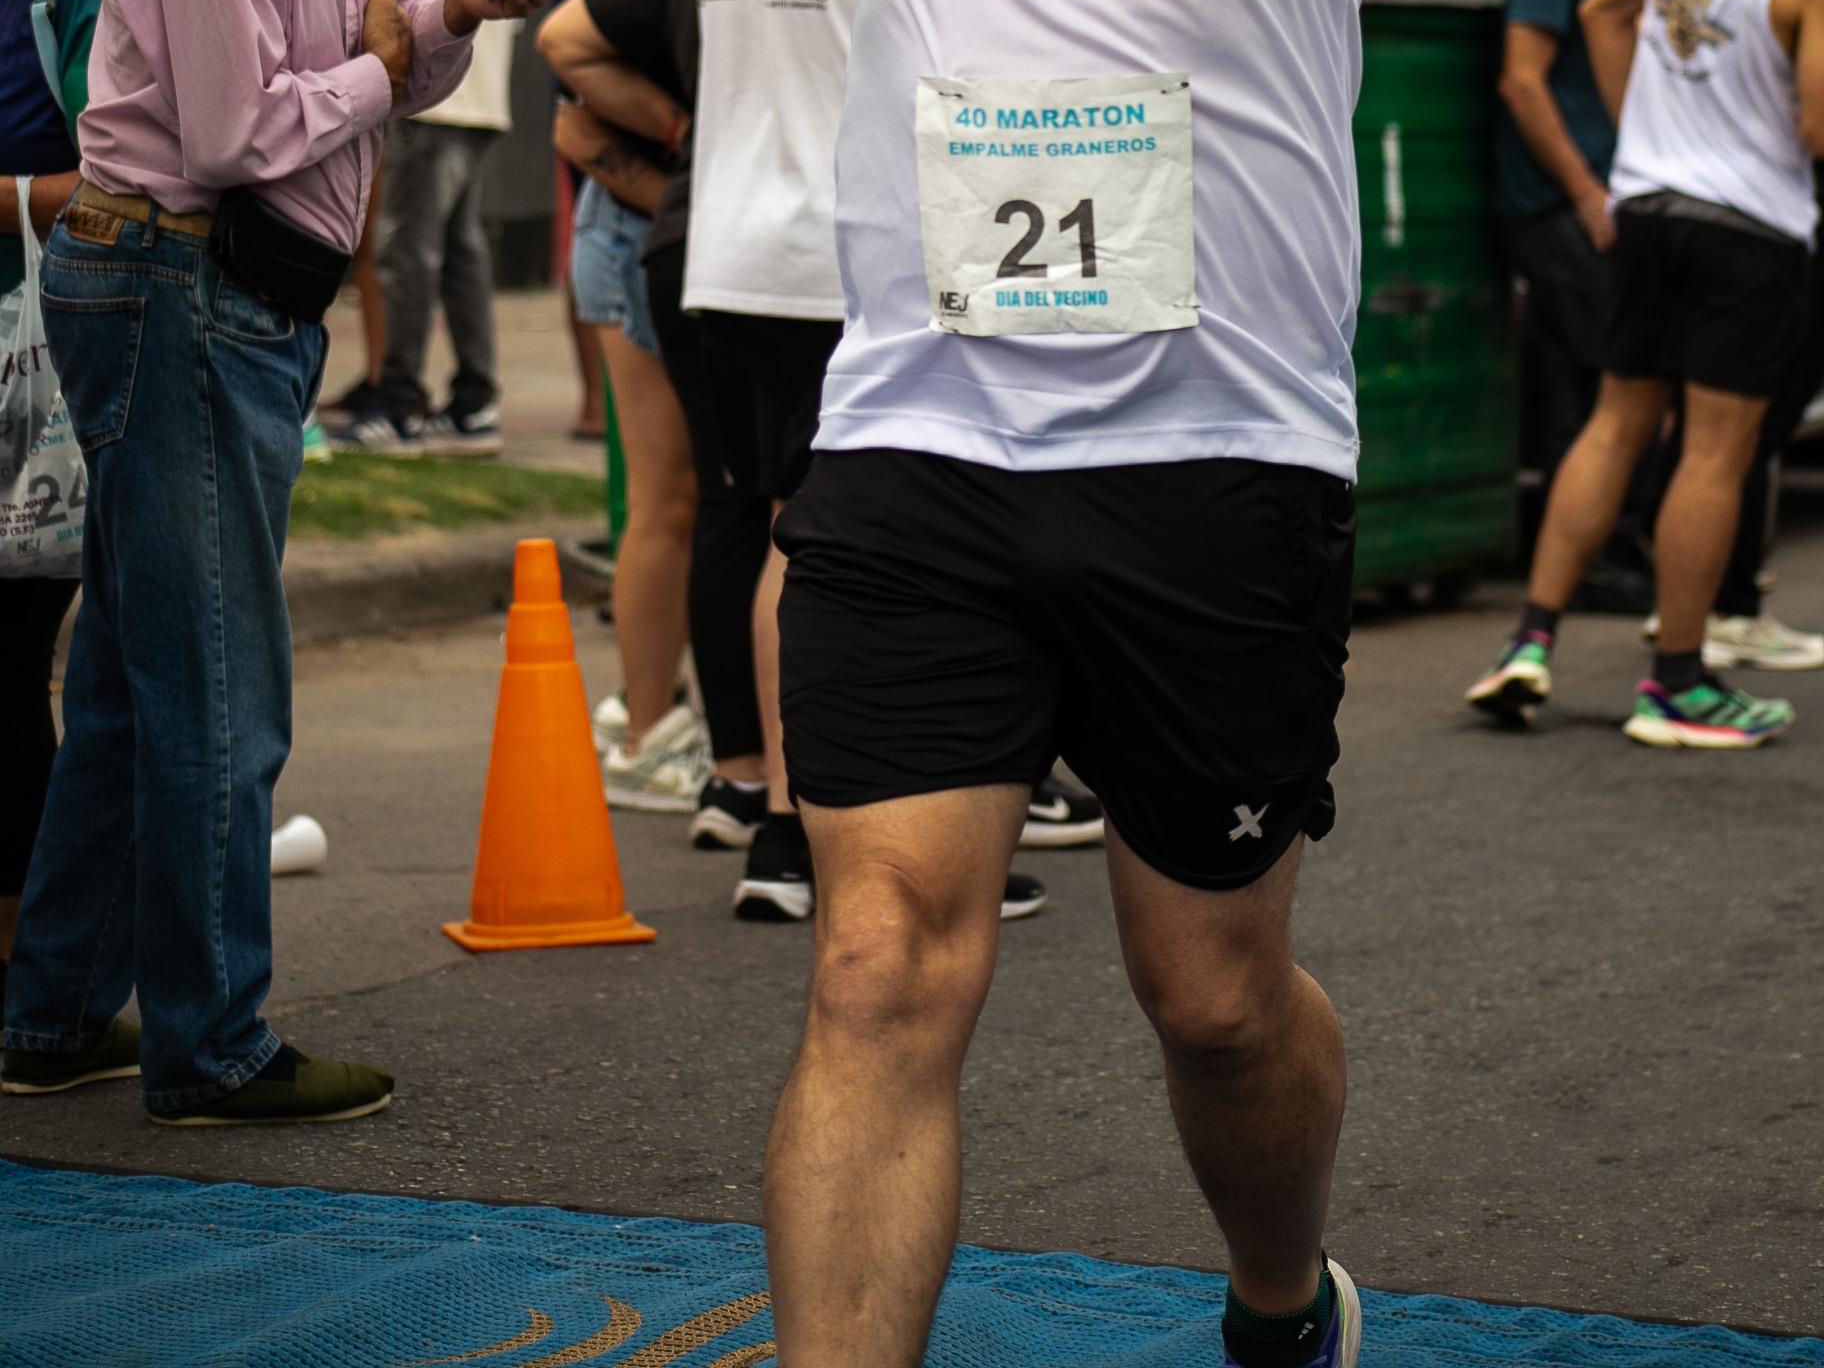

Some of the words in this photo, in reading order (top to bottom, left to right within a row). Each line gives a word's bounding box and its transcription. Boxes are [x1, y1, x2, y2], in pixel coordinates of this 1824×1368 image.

[956, 107, 987, 128] 40
[996, 103, 1146, 129] MARATON
[948, 141, 1040, 158] EMPALME
[1046, 137, 1157, 157] GRANEROS
[994, 198, 1097, 279] 21
[996, 291, 1021, 307] DIA
[1024, 291, 1050, 307] DEL
[1053, 289, 1108, 307] VECINO
